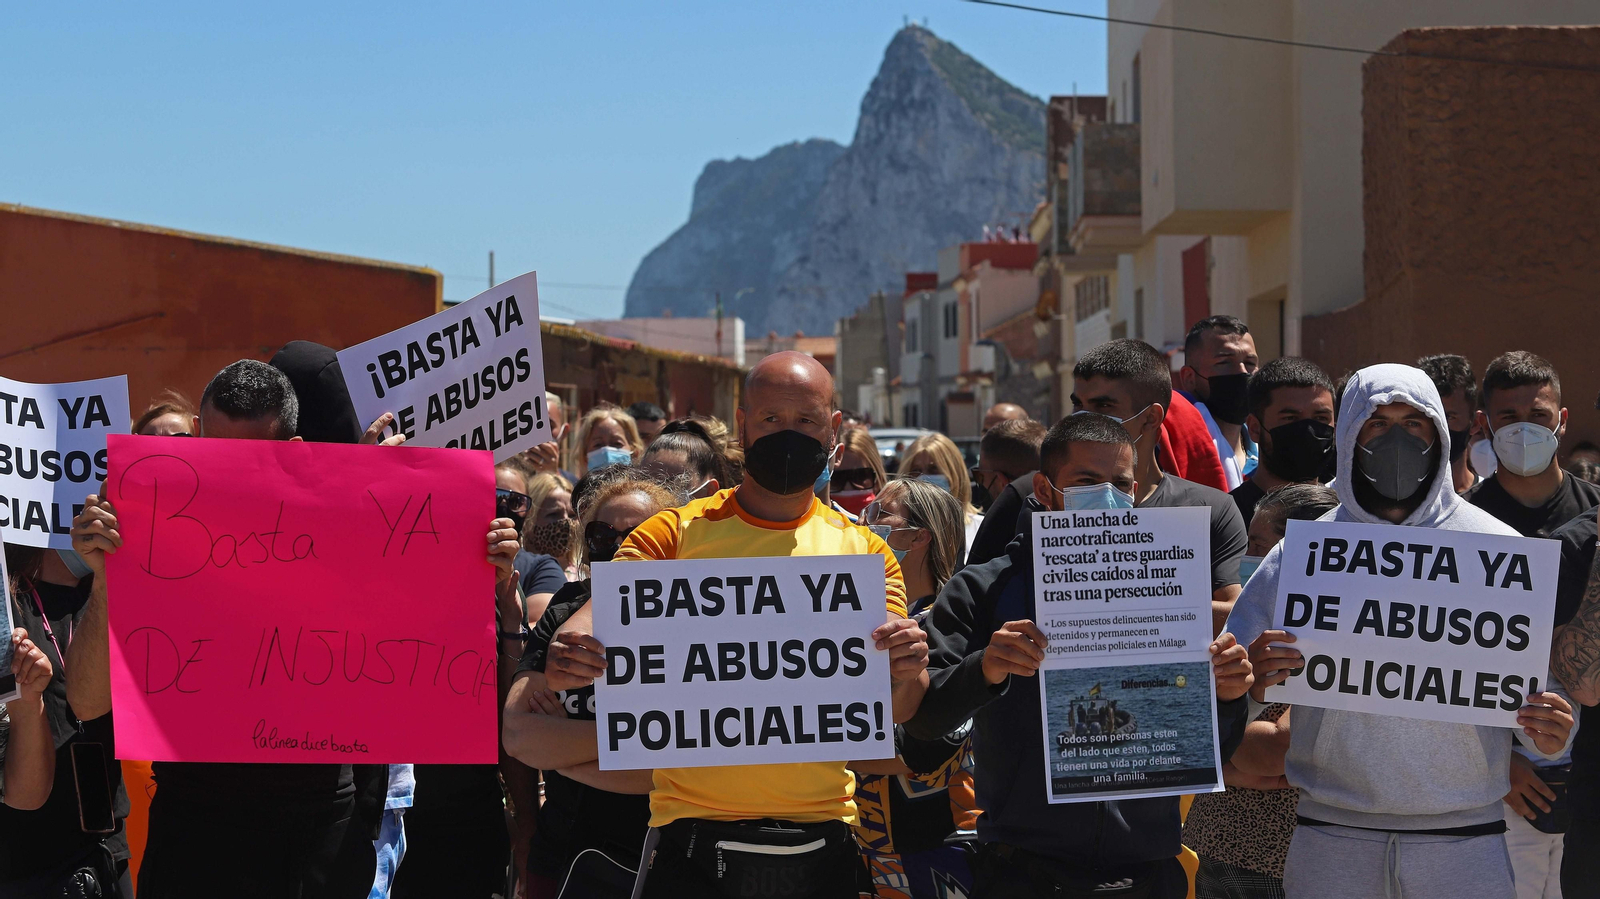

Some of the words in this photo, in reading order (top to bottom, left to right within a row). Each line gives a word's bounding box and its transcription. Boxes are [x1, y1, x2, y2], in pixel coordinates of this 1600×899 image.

[366, 316, 481, 399] ¡BASTA
[484, 294, 524, 338] YA
[424, 347, 531, 432] ABUSOS
[57, 394, 111, 430] YA
[119, 454, 318, 580] Basta
[367, 489, 441, 557] YA
[1040, 515, 1070, 530] Una
[1072, 512, 1120, 528] lancha
[1122, 510, 1139, 526] de
[1041, 530, 1154, 548] narcotraficantes
[1101, 551, 1110, 562] a
[1112, 548, 1138, 562] tres
[1139, 545, 1195, 564] guardias
[1305, 537, 1460, 583] ¡BASTA
[1477, 549, 1533, 591] YA
[1042, 568, 1089, 584] civiles
[1090, 564, 1135, 580] caídos
[1136, 564, 1149, 579] al
[1150, 566, 1177, 578] mar
[618, 574, 786, 626] ¡BASTA
[799, 572, 863, 613] YA
[1043, 588, 1072, 602] tras
[1075, 588, 1103, 600] una
[1104, 581, 1183, 602] persecución
[1051, 618, 1067, 628] Los
[1068, 614, 1110, 628] supuestos
[1112, 612, 1163, 625] delincuentes
[1164, 612, 1179, 622] han
[1180, 611, 1197, 621] sido
[1283, 592, 1341, 631] DE
[1352, 598, 1531, 651] ABUSOS
[1046, 629, 1090, 641] detenidos
[1091, 632, 1096, 641] y
[1098, 629, 1148, 640] permanecen
[1149, 628, 1160, 636] en
[1046, 642, 1107, 655] dependencias
[1108, 639, 1147, 652] policiales
[1148, 640, 1158, 648] en
[1159, 637, 1187, 650] Málaga
[125, 626, 214, 696] DE
[248, 625, 497, 705] INJUSTICIA
[605, 644, 666, 686] DE
[682, 636, 867, 683] ABUSOS
[607, 701, 886, 752] POLICIALES!
[1058, 734, 1087, 744] Todos
[1090, 734, 1107, 742] son
[1110, 732, 1151, 743] personas
[1153, 728, 1178, 738] esten
[1061, 748, 1076, 758] del
[1079, 746, 1100, 756] lado
[1102, 746, 1120, 757] que
[1122, 745, 1150, 755] esten,
[1152, 742, 1176, 752] todos
[1056, 762, 1088, 772] tienen
[1090, 761, 1107, 769] una
[1110, 758, 1130, 768] vida
[1132, 758, 1147, 769] por
[1149, 754, 1182, 765] delante
[1093, 774, 1111, 784] una
[1113, 770, 1148, 782] familia.
